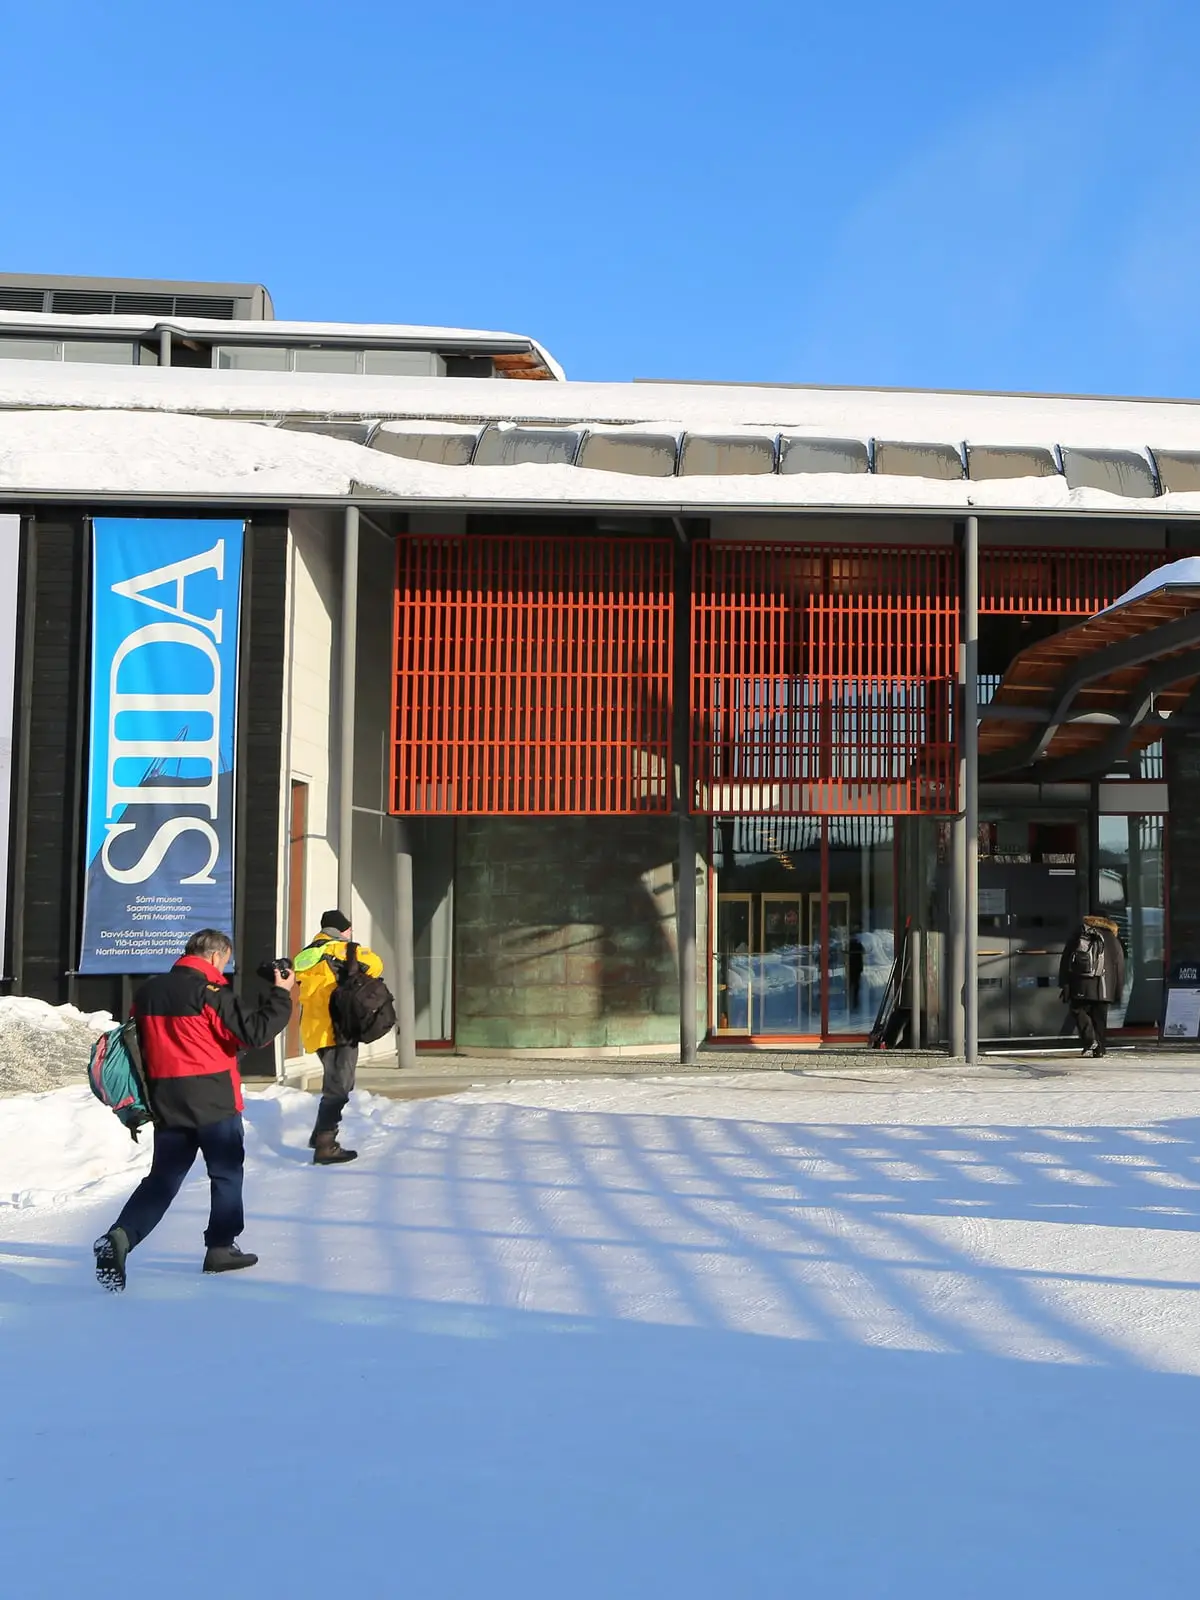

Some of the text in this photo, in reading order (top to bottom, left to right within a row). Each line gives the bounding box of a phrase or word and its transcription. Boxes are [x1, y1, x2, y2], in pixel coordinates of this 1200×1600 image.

[101, 538, 225, 885] SIIDA
[135, 895, 155, 903] Sámi
[126, 904, 192, 912] Saamelaismuseo
[132, 912, 152, 920] Sámi
[131, 948, 163, 956] Lapland
